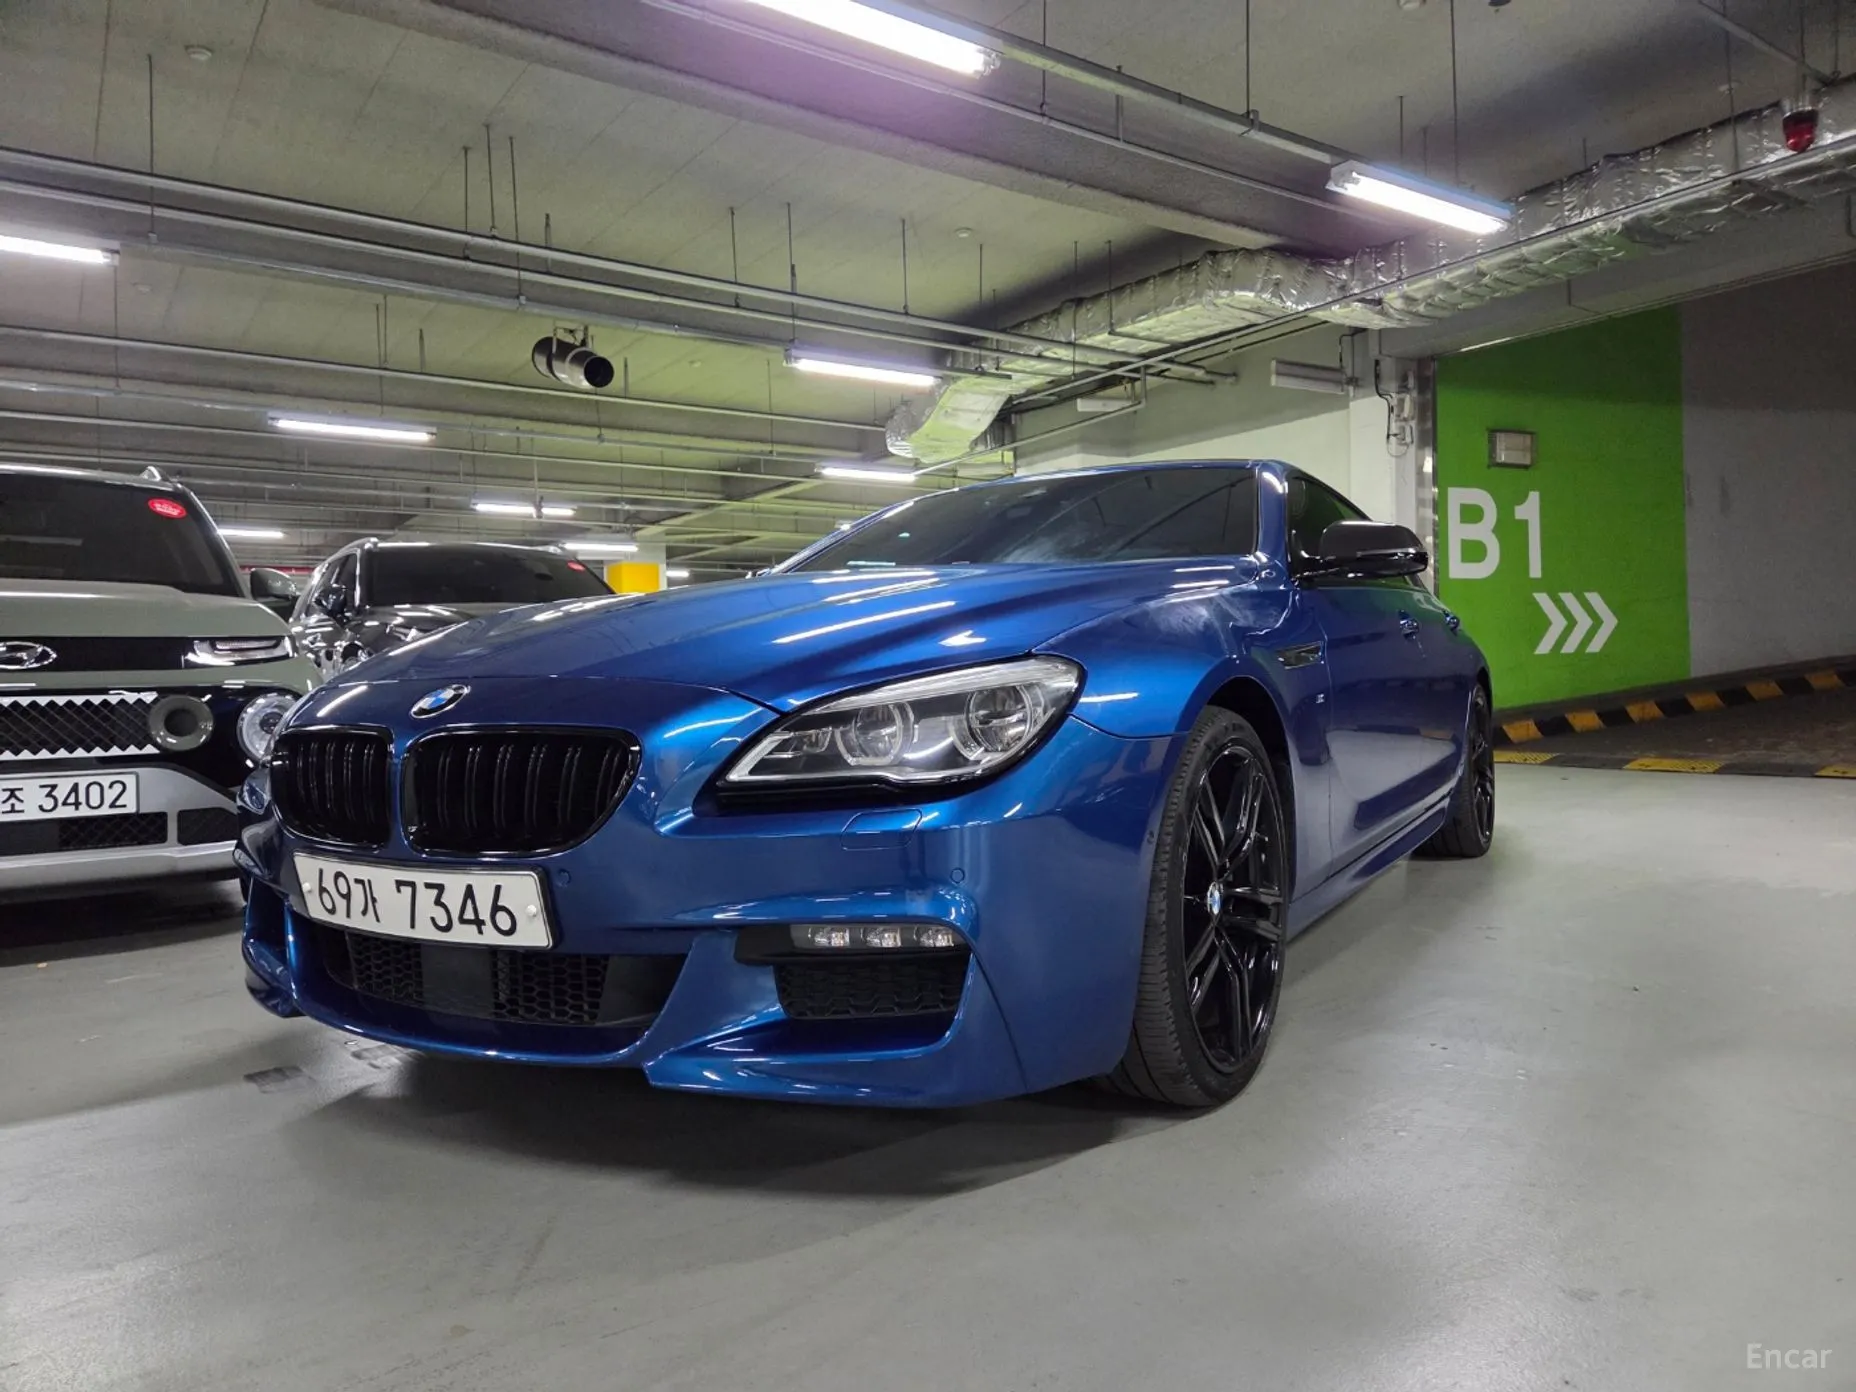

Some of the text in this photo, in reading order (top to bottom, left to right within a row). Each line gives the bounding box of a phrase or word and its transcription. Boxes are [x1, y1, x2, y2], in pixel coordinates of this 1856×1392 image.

[1447, 487, 1542, 579] B1
[38, 780, 127, 812] 3402
[318, 868, 517, 936] 69가 7346
